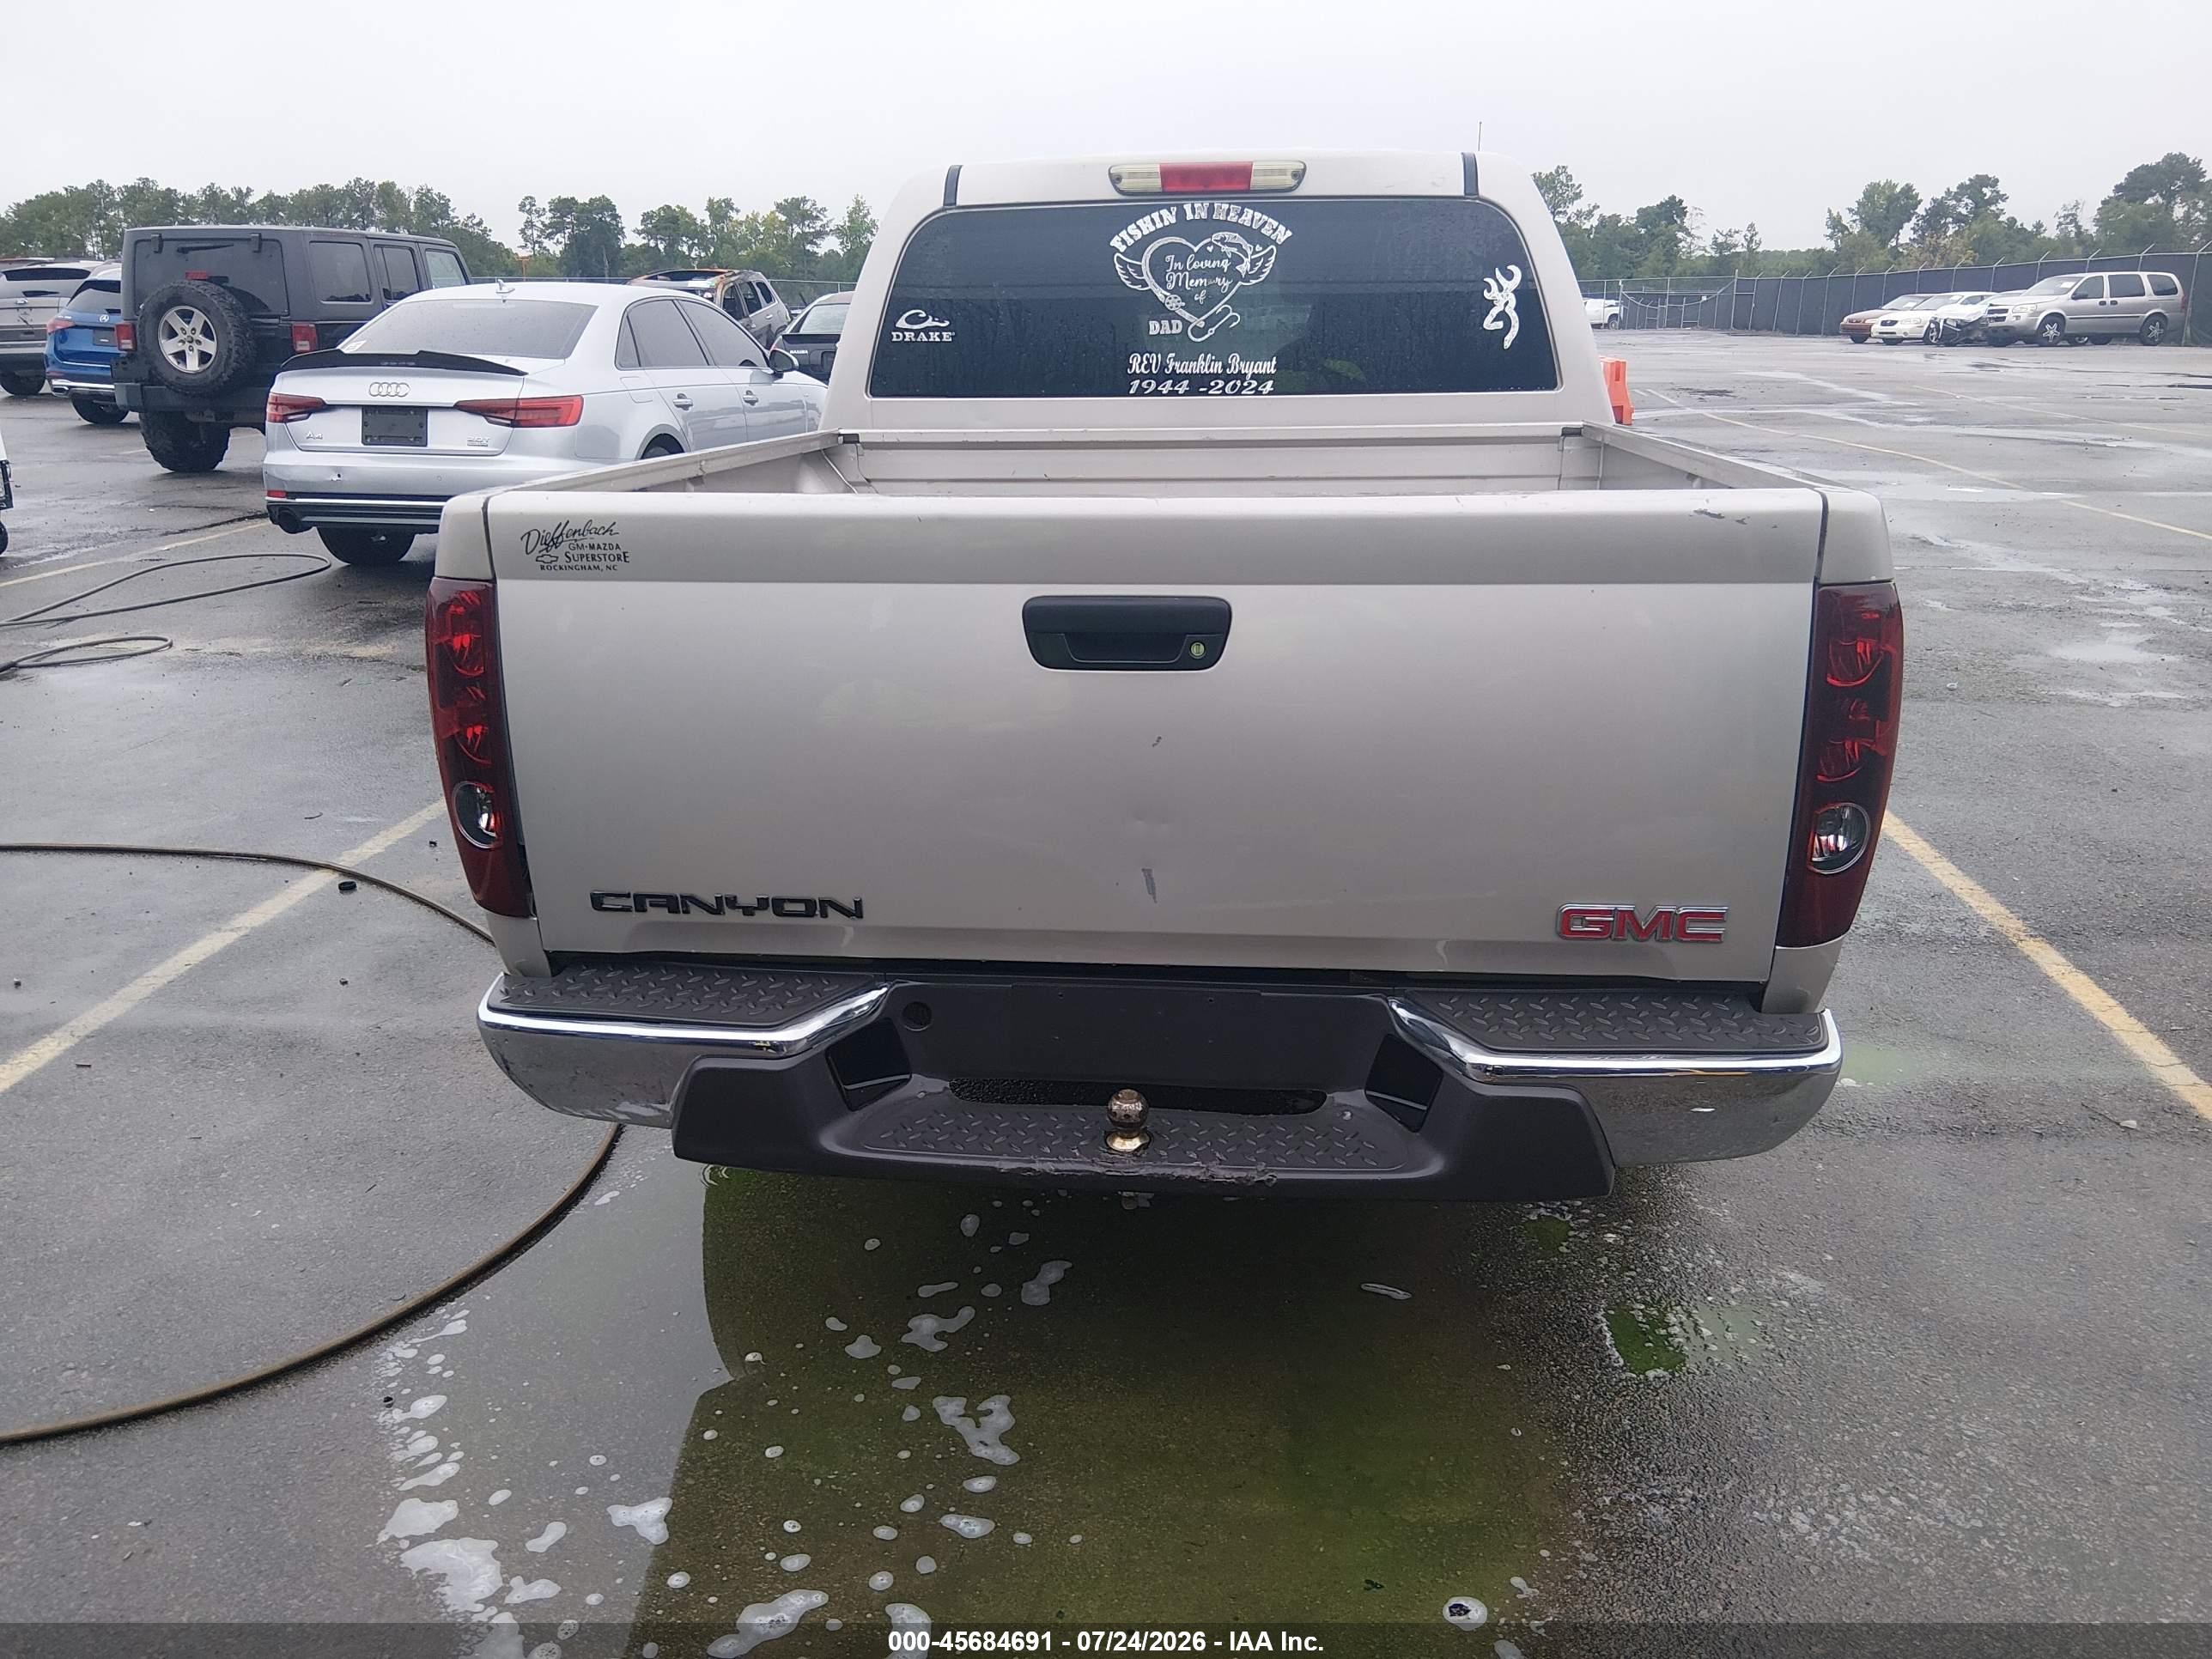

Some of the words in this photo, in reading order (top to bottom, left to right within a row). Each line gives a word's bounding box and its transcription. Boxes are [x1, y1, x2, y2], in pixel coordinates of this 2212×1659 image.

[1183, 203, 1210, 221] IN
[1212, 203, 1292, 245] HEAVEN
[1165, 254, 1184, 272] In
[1186, 254, 1231, 272] loving
[1194, 289, 1206, 305] of
[1149, 319, 1183, 335] DAD
[1127, 353, 1161, 374] REV
[1164, 353, 1223, 374] Franklin
[1226, 353, 1277, 380] Bryant
[1129, 380, 1189, 394] 1944
[564, 551, 629, 563] SUPERSTORE
[590, 890, 864, 920] CANYON
[1557, 903, 1729, 944] GMC
